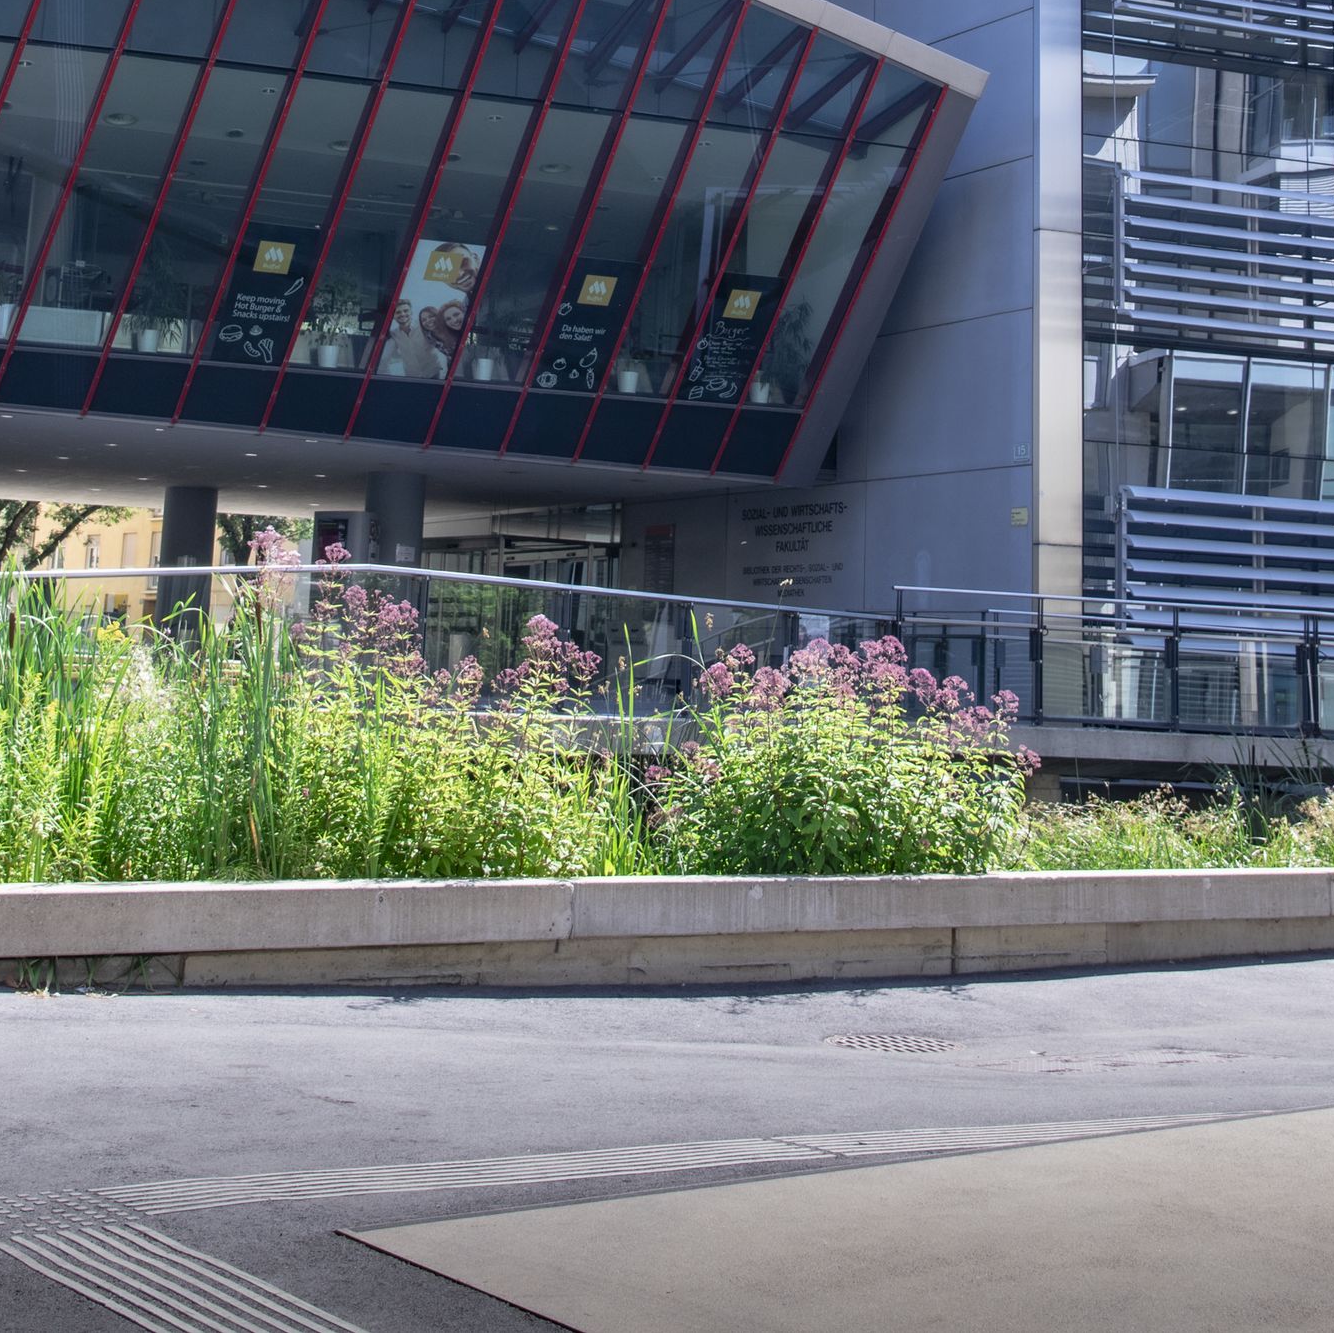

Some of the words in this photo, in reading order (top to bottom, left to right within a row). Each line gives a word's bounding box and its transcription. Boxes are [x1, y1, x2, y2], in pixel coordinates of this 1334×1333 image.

[236, 293, 256, 303] Keep
[234, 301, 249, 309] Hot
[249, 303, 275, 313] Burger
[275, 305, 283, 313] &
[232, 309, 258, 319] Snacks
[258, 313, 291, 323] upstairs!
[561, 324, 572, 332] Da
[572, 324, 594, 334] haben
[595, 328, 607, 336] wir
[559, 332, 573, 340] den
[573, 333, 593, 342] Salat!
[741, 507, 771, 521] SOZIAL-
[772, 506, 788, 518] UND
[790, 501, 848, 517] WIRTSCHAFTS-
[754, 520, 833, 537] WISSENSCHAFTLICHE
[775, 537, 809, 553] FAKULTÄT
[771, 565, 782, 574] DER
[831, 562, 844, 571] UND
